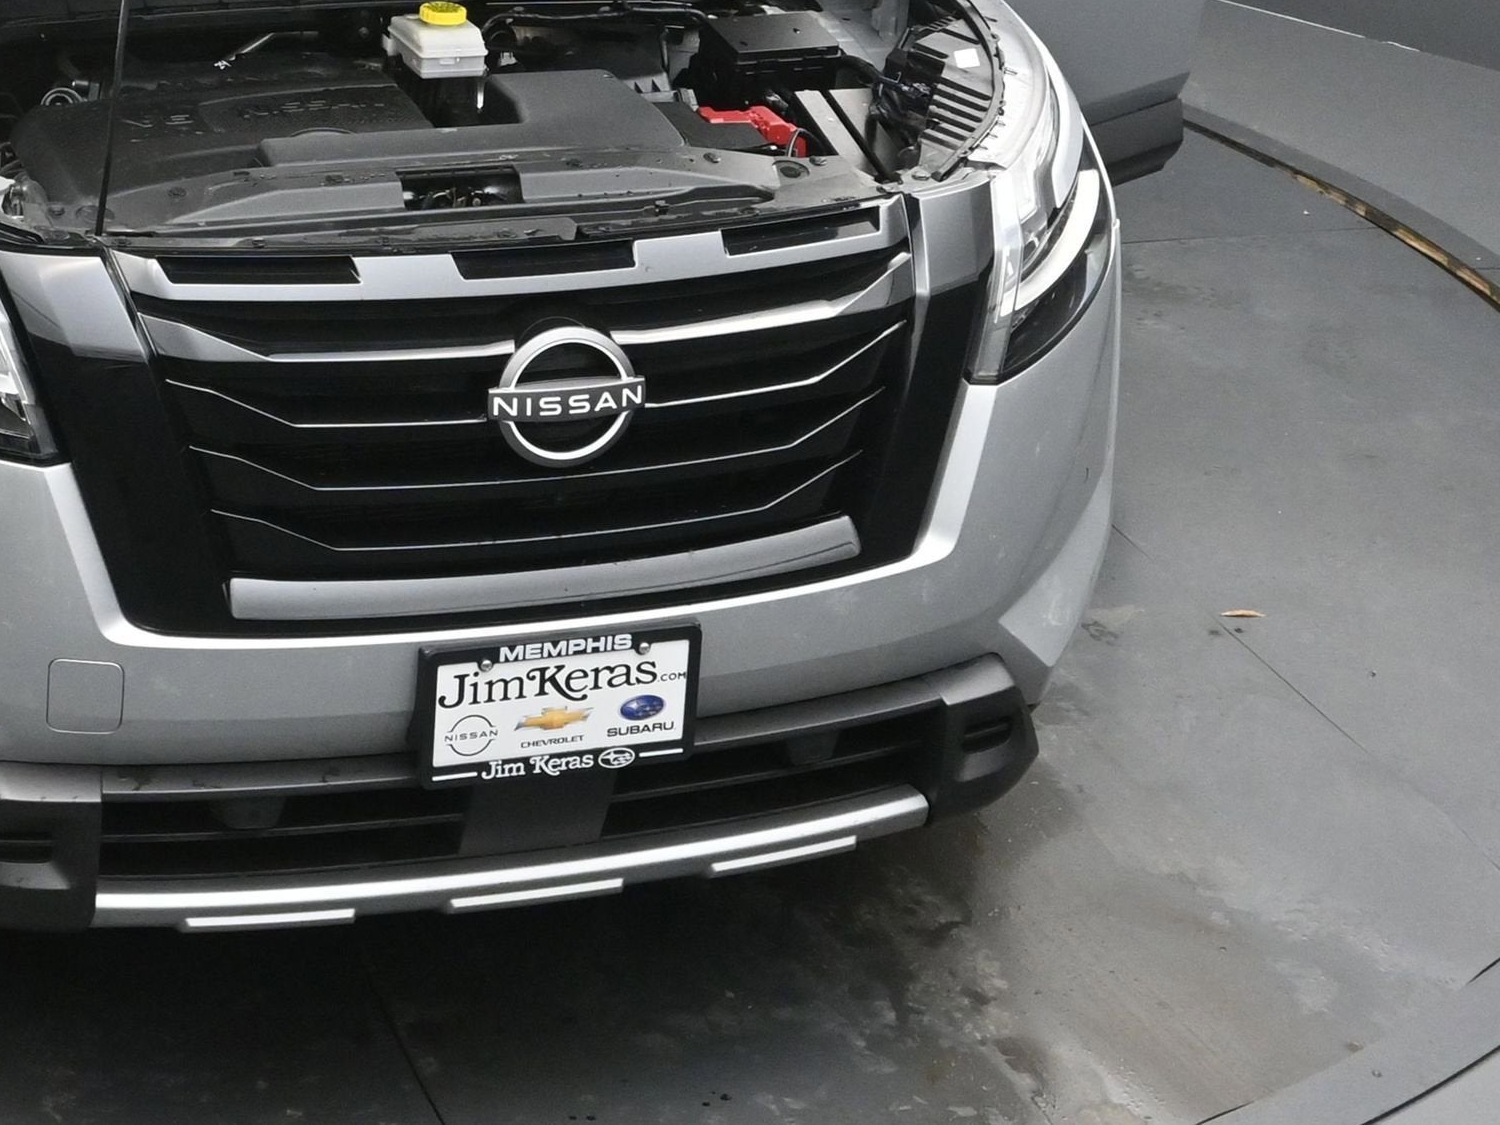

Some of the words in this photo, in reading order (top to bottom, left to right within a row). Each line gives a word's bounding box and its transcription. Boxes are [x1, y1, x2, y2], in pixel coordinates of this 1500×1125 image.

[493, 385, 642, 416] NISSAN
[499, 633, 632, 663] MEMPHIS
[444, 729, 498, 742] NISSAN
[606, 721, 674, 737] SUBARU
[520, 734, 584, 749] CHEVROLET
[481, 760, 526, 780] Jim
[529, 753, 594, 776] Keras
